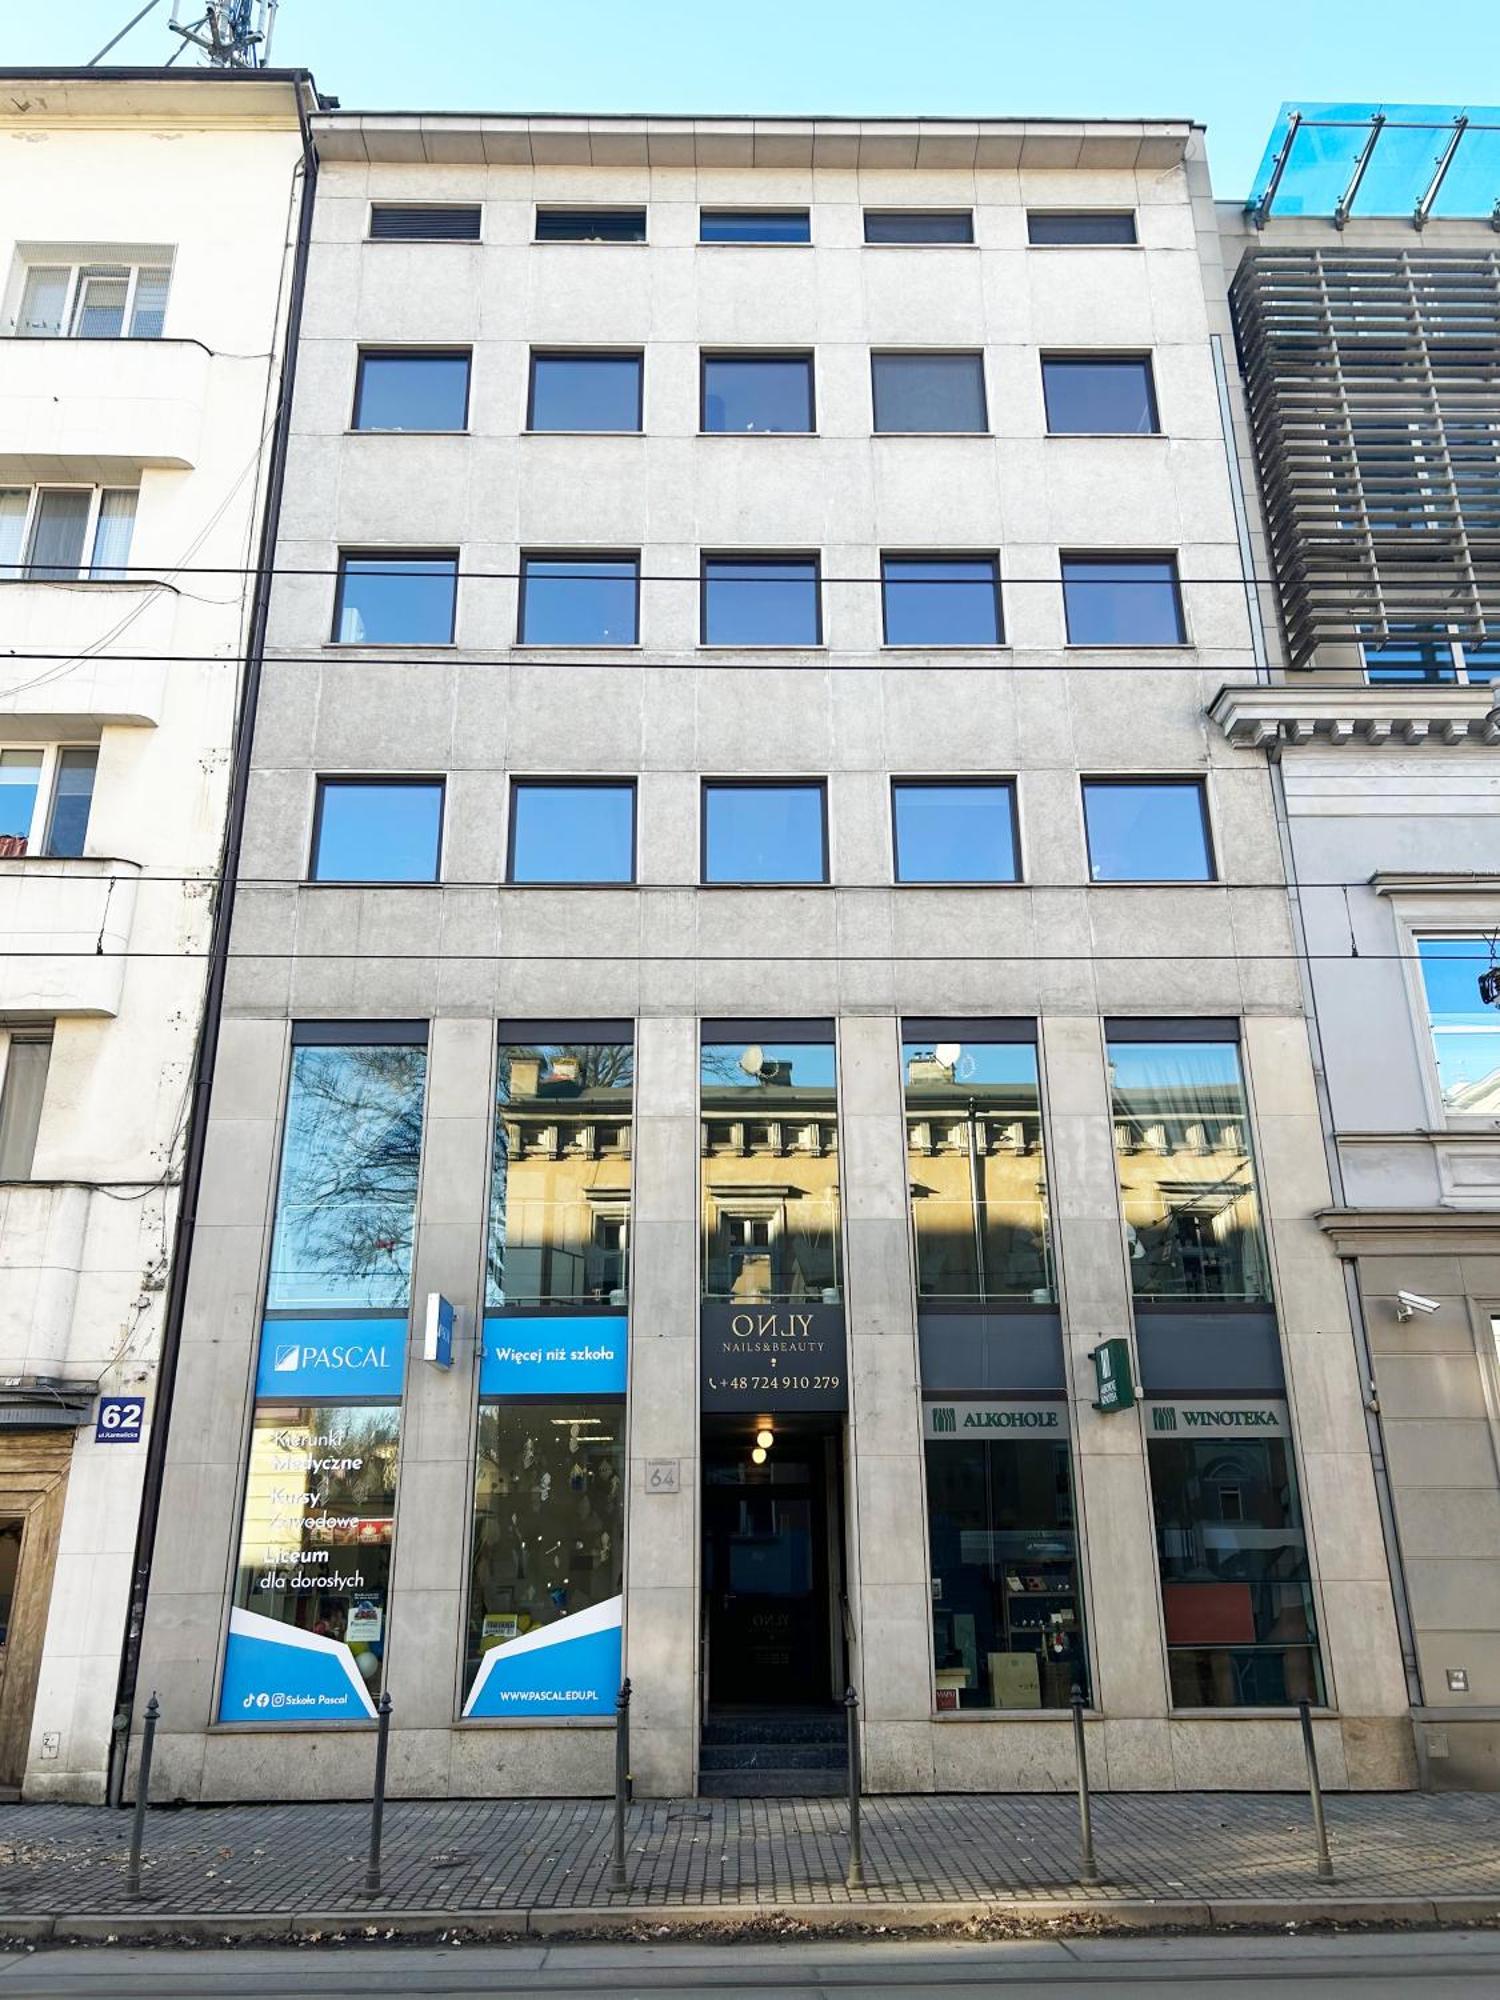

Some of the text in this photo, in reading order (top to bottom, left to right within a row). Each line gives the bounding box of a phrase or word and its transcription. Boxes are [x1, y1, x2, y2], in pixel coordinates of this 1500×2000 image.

[495, 1345, 614, 1365] Więcej niż szkoła
[723, 1342, 824, 1352] NAILS&BEAUTY
[302, 1346, 391, 1368] PASCAL
[719, 1376, 840, 1389] +48 724 910 279
[102, 1404, 141, 1428] 62
[963, 1412, 1058, 1427] ALKOHOLE
[1182, 1411, 1280, 1426] WINOTEKA
[275, 1429, 344, 1447] Kierunki
[272, 1452, 363, 1475] Medyczne
[650, 1468, 674, 1487] 64
[270, 1488, 320, 1508] Kursy
[263, 1547, 329, 1563] Liceum
[260, 1569, 364, 1591] dla dorosłych
[286, 1693, 347, 1705] Szkoła Pascal
